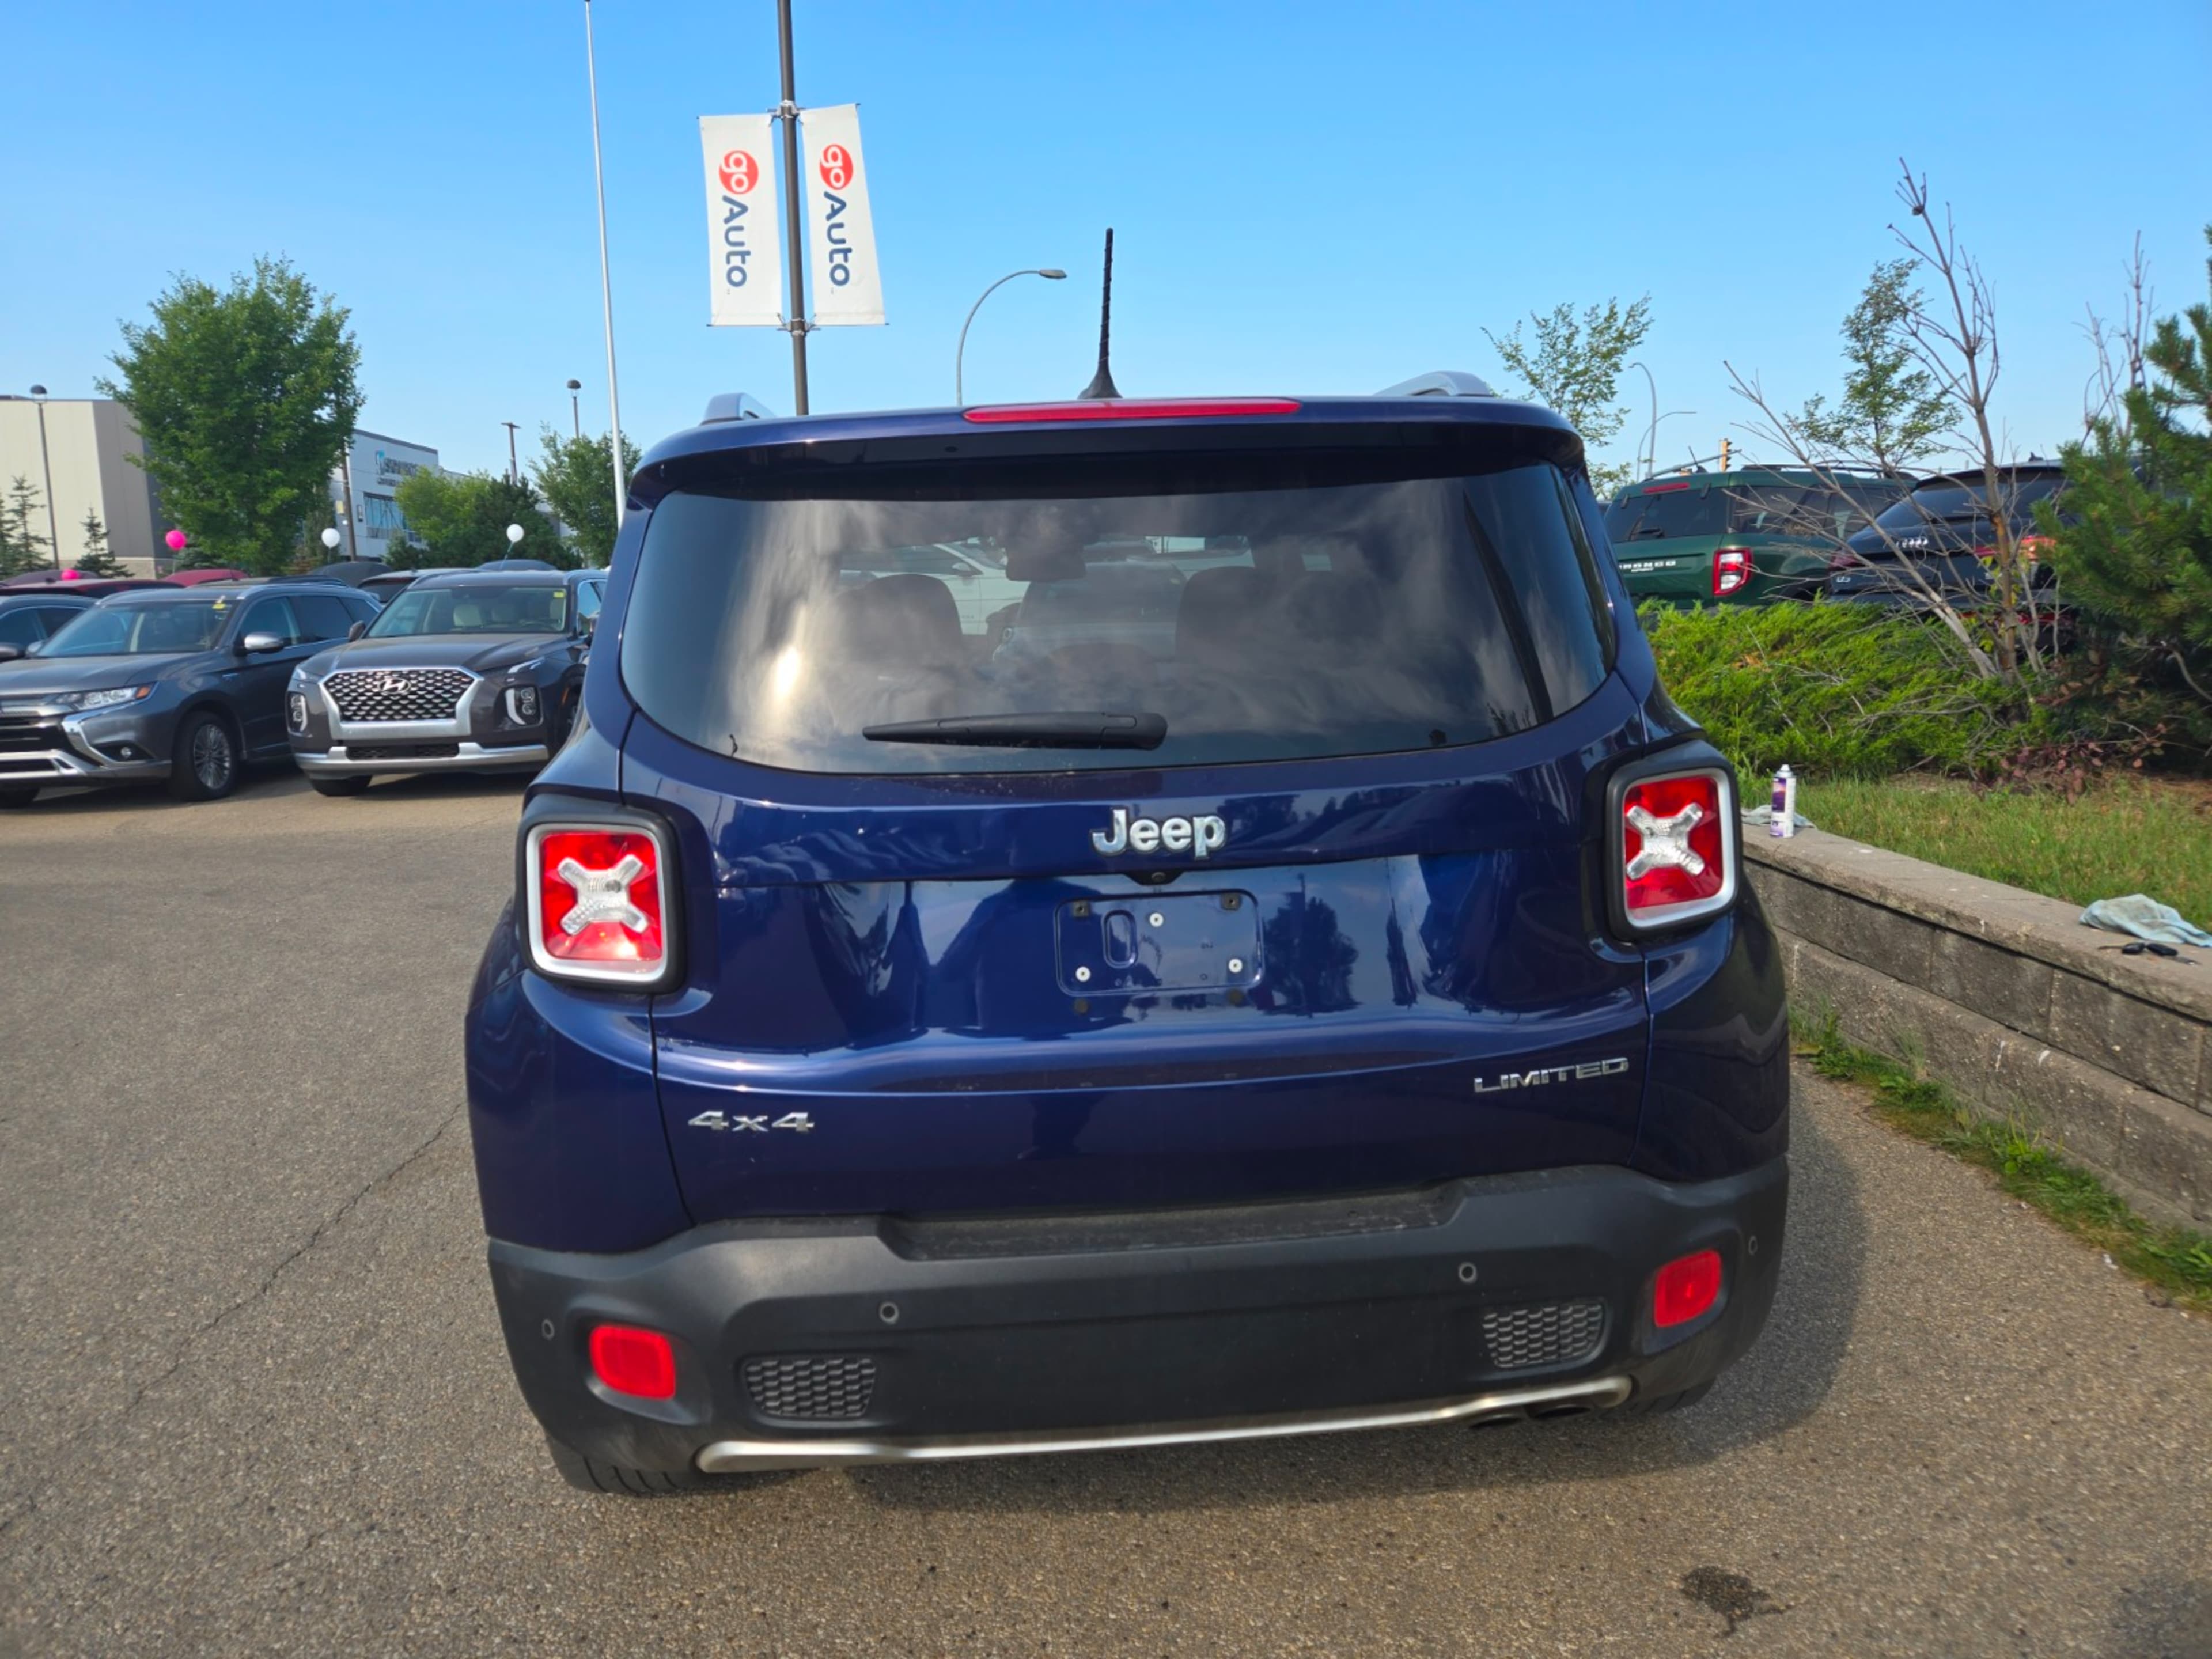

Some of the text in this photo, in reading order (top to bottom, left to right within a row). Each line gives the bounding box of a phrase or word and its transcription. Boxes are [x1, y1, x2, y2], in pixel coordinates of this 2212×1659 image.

[1092, 806, 1226, 858] Jeep
[1474, 1057, 1629, 1093] LIMITED
[688, 1110, 815, 1132] 4x4
